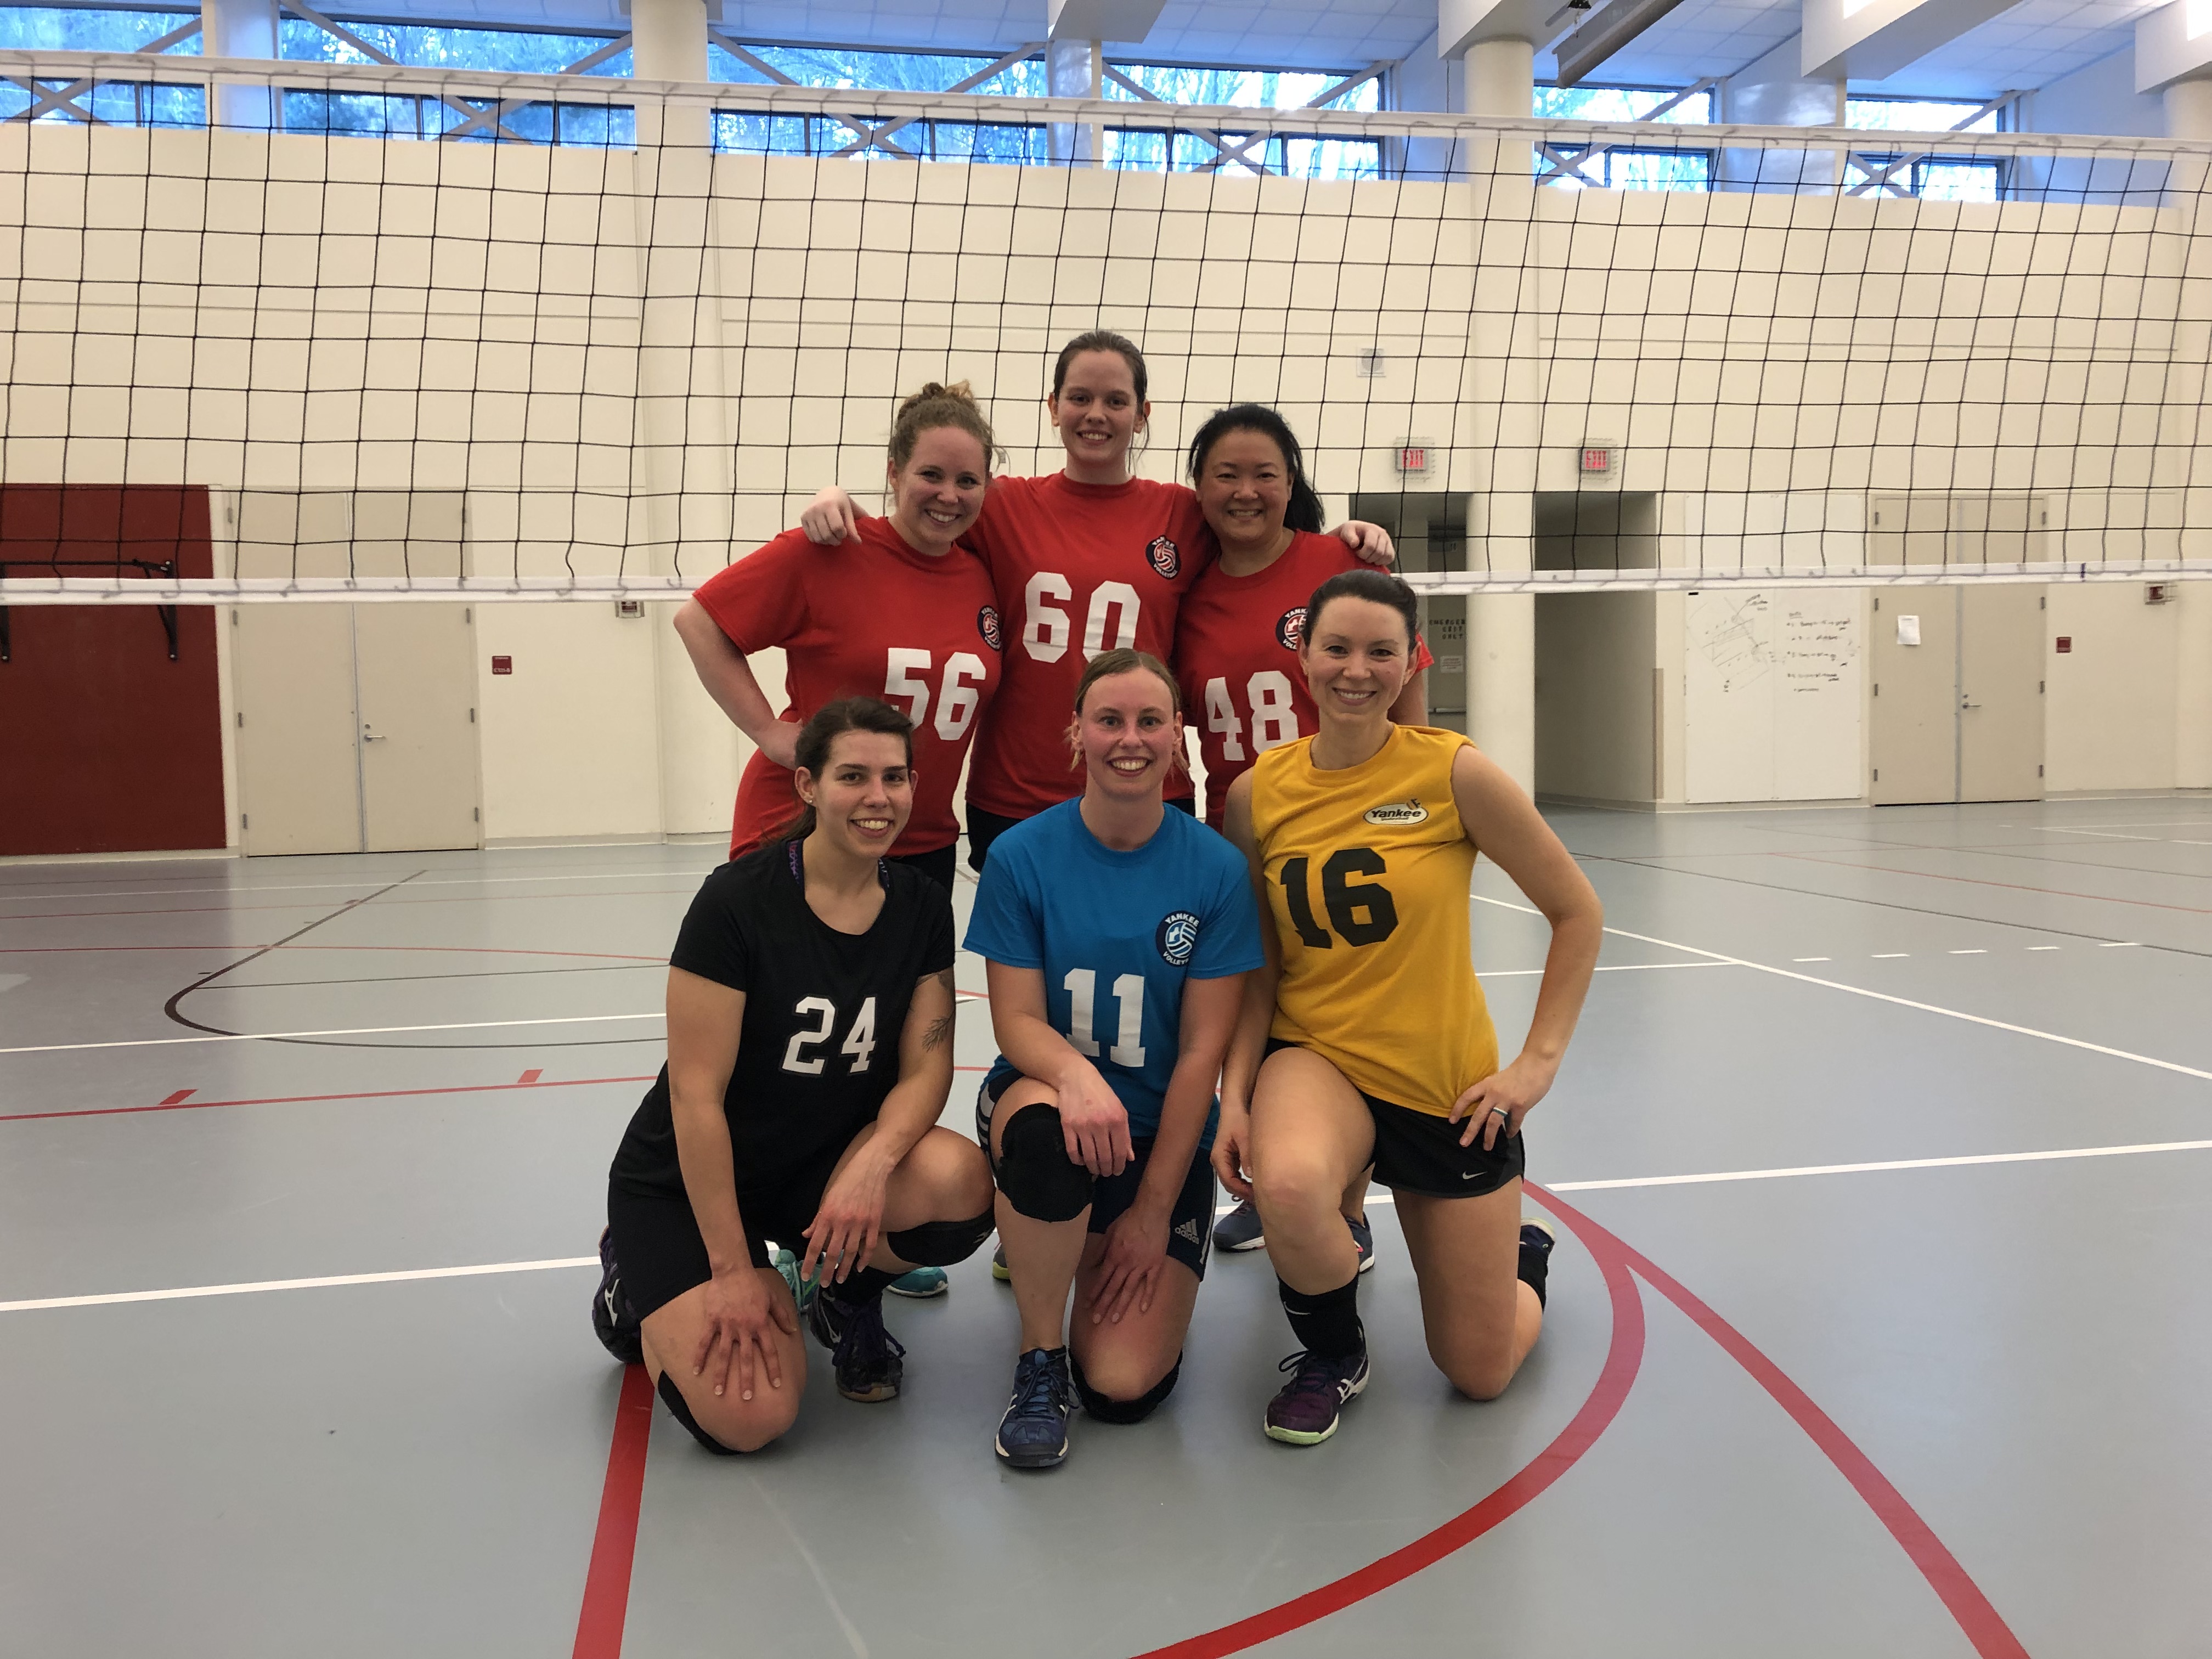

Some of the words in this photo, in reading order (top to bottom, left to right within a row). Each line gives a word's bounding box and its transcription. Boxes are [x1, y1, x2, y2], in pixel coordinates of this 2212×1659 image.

[1402, 449, 1424, 468] EXIT
[1585, 450, 1606, 469] EXIT
[1023, 571, 1141, 663] 60
[1284, 608, 1308, 618] YANK
[884, 647, 986, 741] 56
[1205, 670, 1299, 761] 48
[1372, 809, 1421, 817] Yankee
[1281, 848, 1399, 949] 16
[1165, 913, 1200, 927] YANKEE
[1163, 951, 1189, 964] VOLLEY
[1064, 968, 1146, 1067] 11
[782, 996, 876, 1074] 24
[1175, 1227, 1199, 1244] adidas
